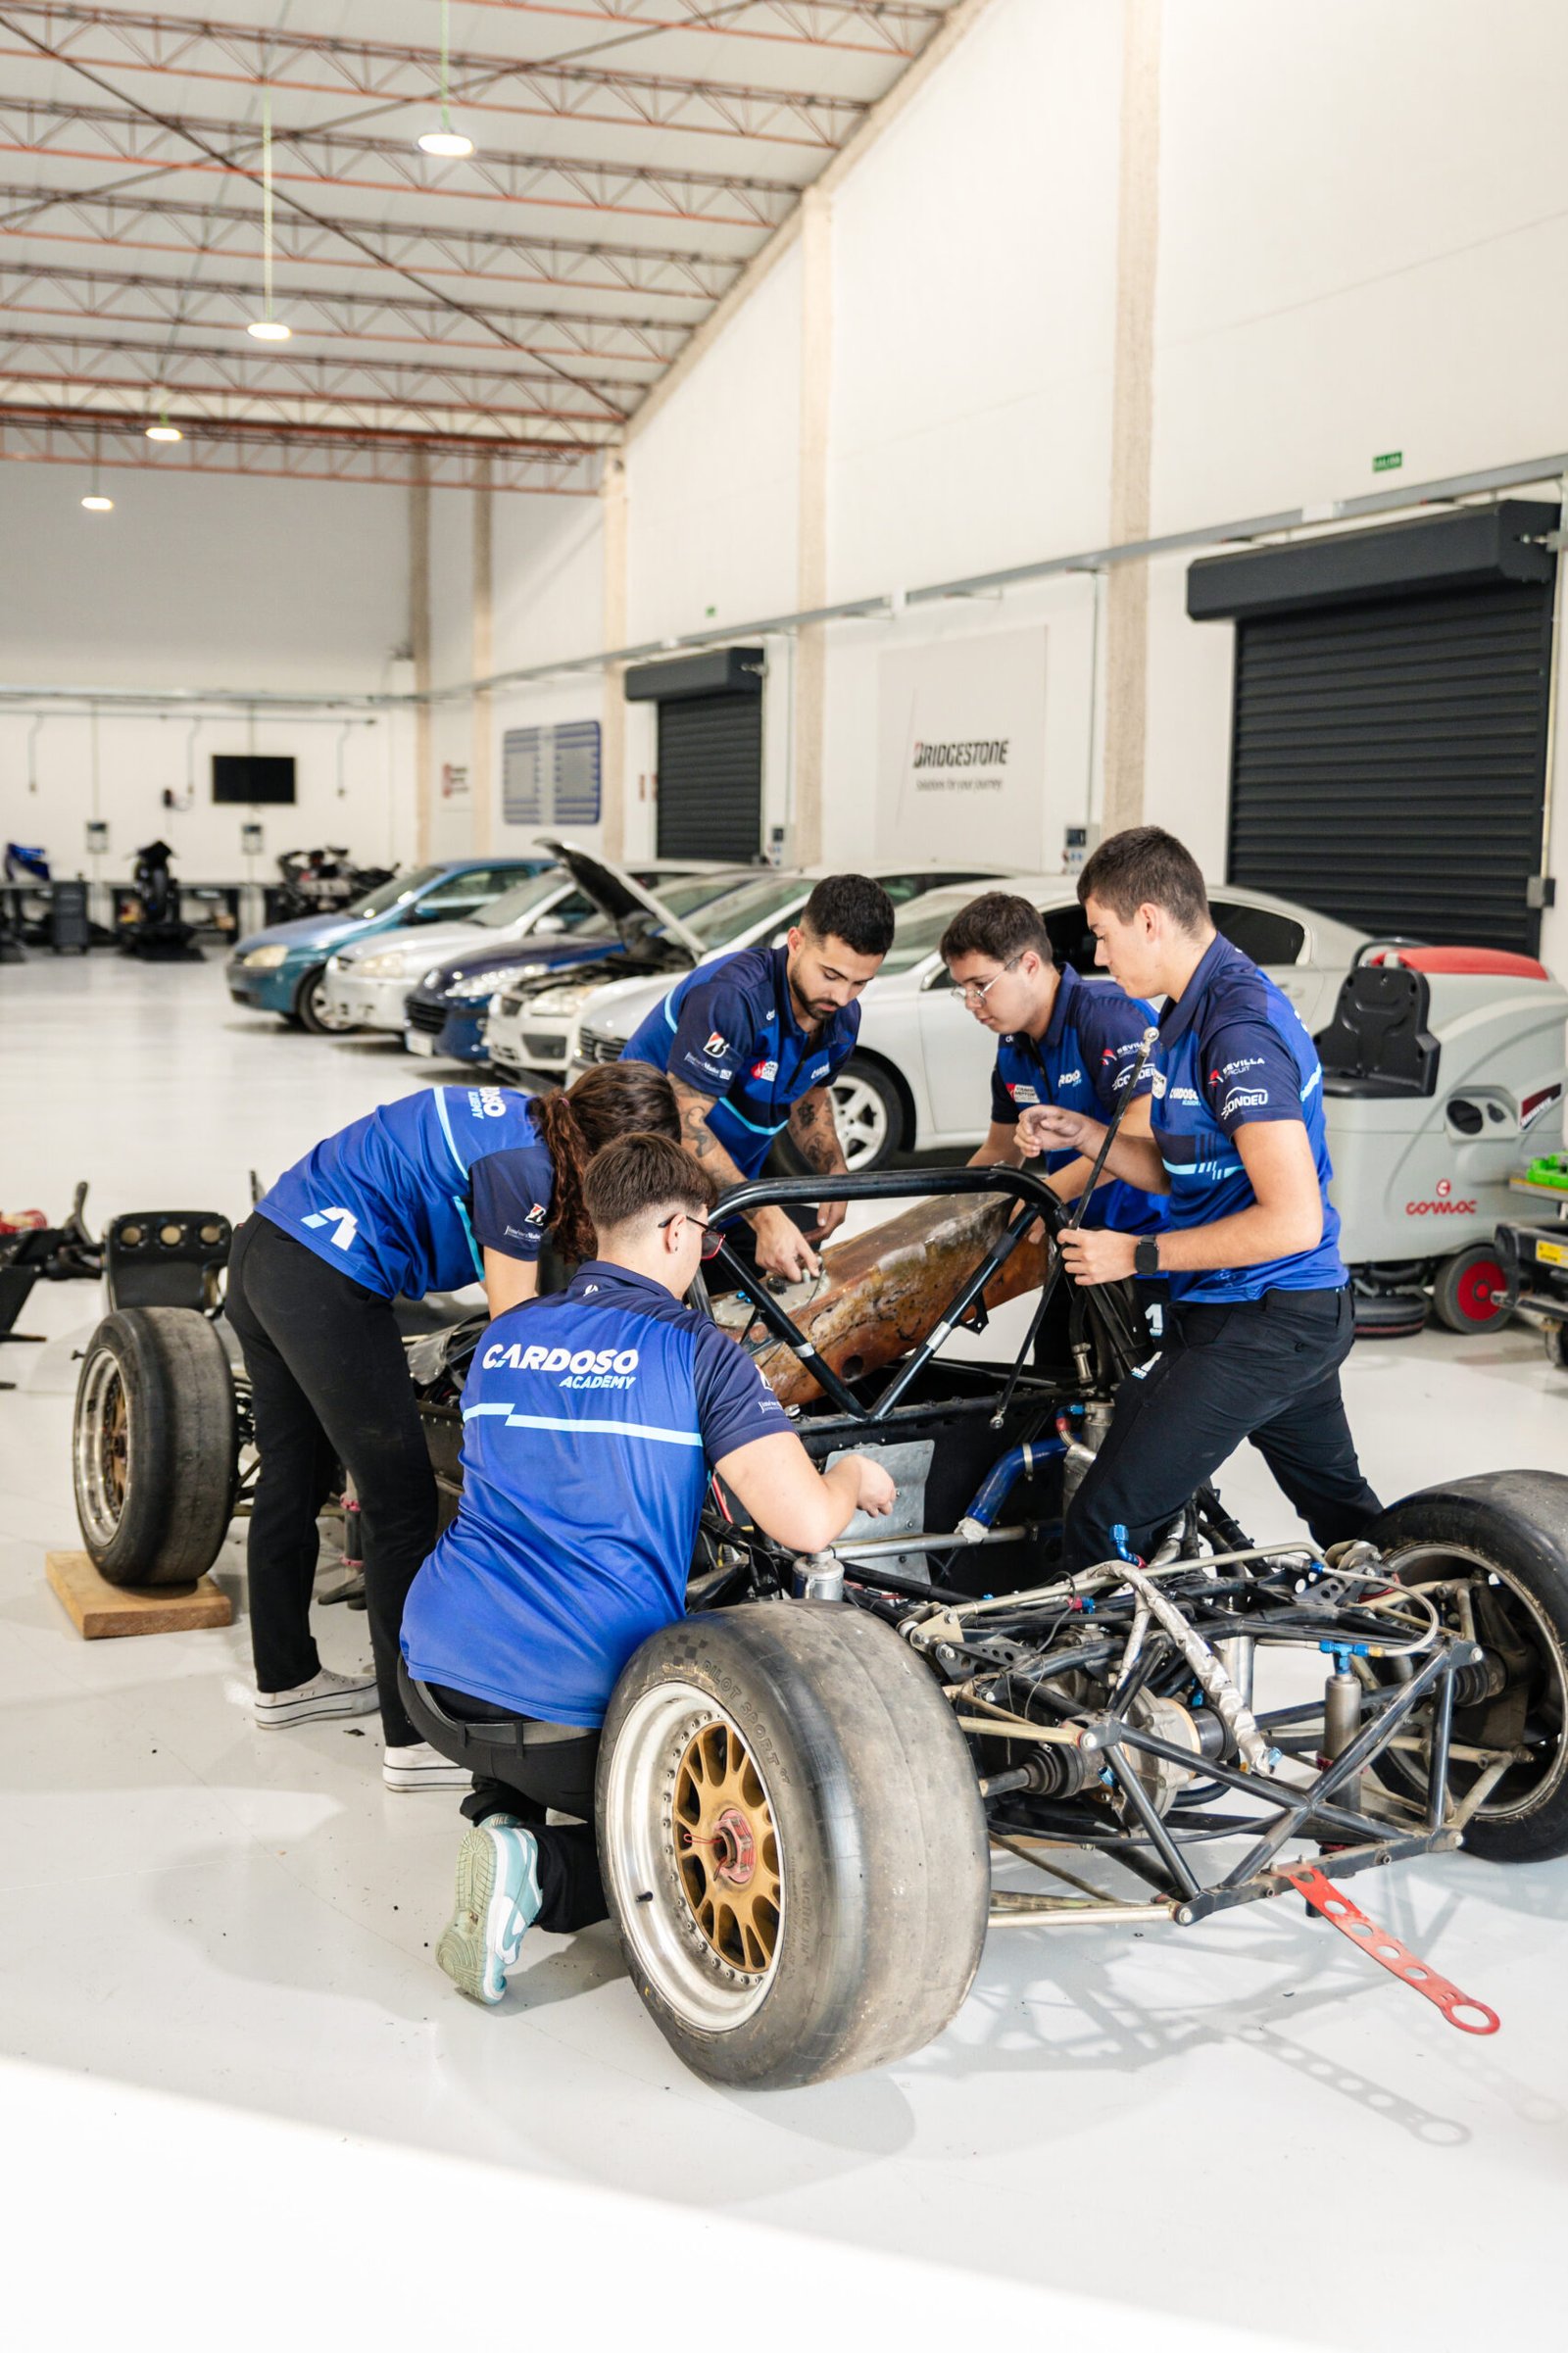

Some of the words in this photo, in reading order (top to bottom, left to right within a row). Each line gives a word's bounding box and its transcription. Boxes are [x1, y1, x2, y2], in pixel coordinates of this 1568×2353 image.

[913, 740, 1008, 767] BRIDGESTONE
[1116, 1042, 1145, 1054] SEVILL
[1223, 1057, 1265, 1074] SEVILLA
[482, 1344, 639, 1375] CARDOSO
[559, 1375, 637, 1390] ACADEMY
[703, 1659, 743, 1699] PILOT
[740, 1701, 780, 1766] SPORT
[491, 1816, 510, 1827] NIKE
